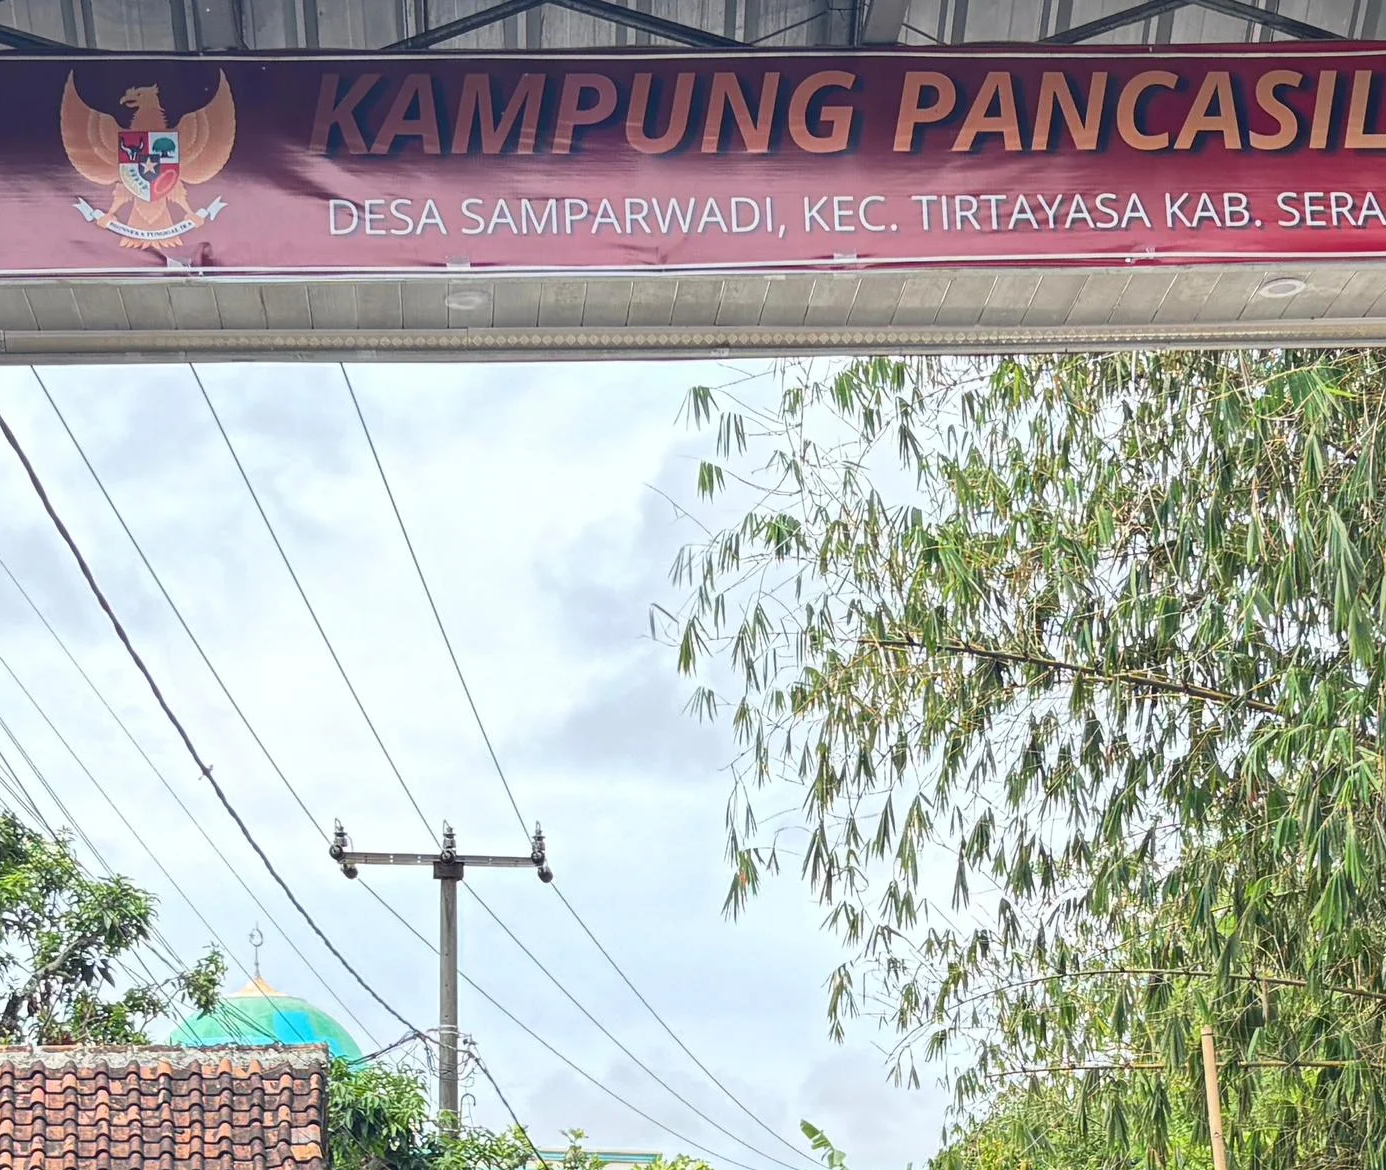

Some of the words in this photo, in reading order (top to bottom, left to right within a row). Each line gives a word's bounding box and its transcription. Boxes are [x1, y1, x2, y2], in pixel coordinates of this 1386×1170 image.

[310, 70, 858, 155] KAMPUNG
[328, 198, 447, 236] DESA
[460, 196, 786, 238] SAMPARWADI,
[803, 194, 898, 233] KEC.
[912, 192, 1151, 231] TIRTAYASA
[1165, 191, 1263, 230] KAB.
